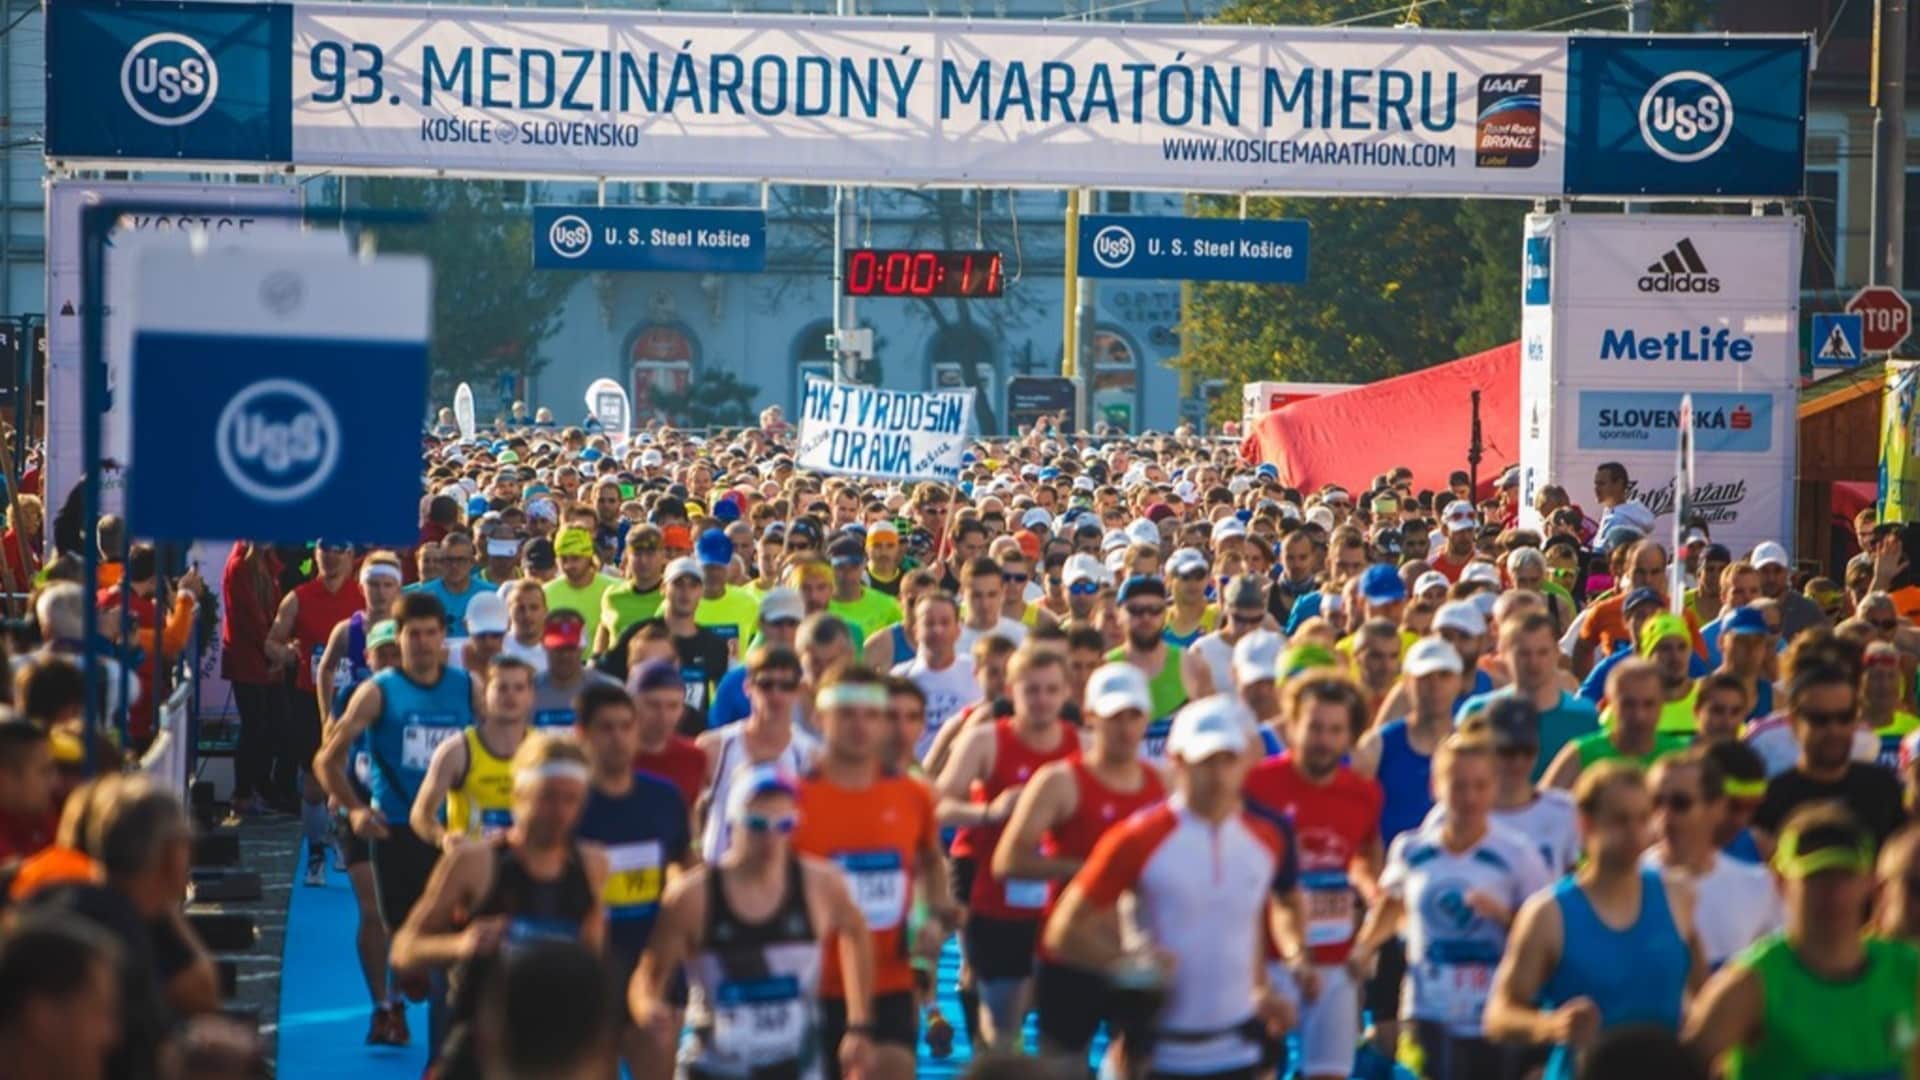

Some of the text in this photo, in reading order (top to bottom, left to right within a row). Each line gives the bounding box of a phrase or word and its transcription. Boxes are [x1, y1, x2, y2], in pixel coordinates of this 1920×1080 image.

[310, 40, 1458, 132] 93. MEDZINÁRODNÝ MARATÓN MIERU
[1482, 78, 1529, 93] IAAF
[421, 115, 639, 148] KOŠICE SLOVENSKO
[1480, 135, 1535, 149] BRONZE
[1162, 138, 1456, 168] WWW.KOSICEMARATHON.COM
[605, 228, 750, 248] U. S. Steel Košice
[1148, 238, 1293, 259] U. S. Steel Košice
[849, 252, 998, 294] 0:00:11
[1637, 272, 1721, 293] adidas
[1853, 309, 1905, 333] TOP
[1600, 326, 1753, 362] MetLife
[1599, 407, 1726, 430] SLOVENKÁ
[829, 429, 912, 474] ORAVA
